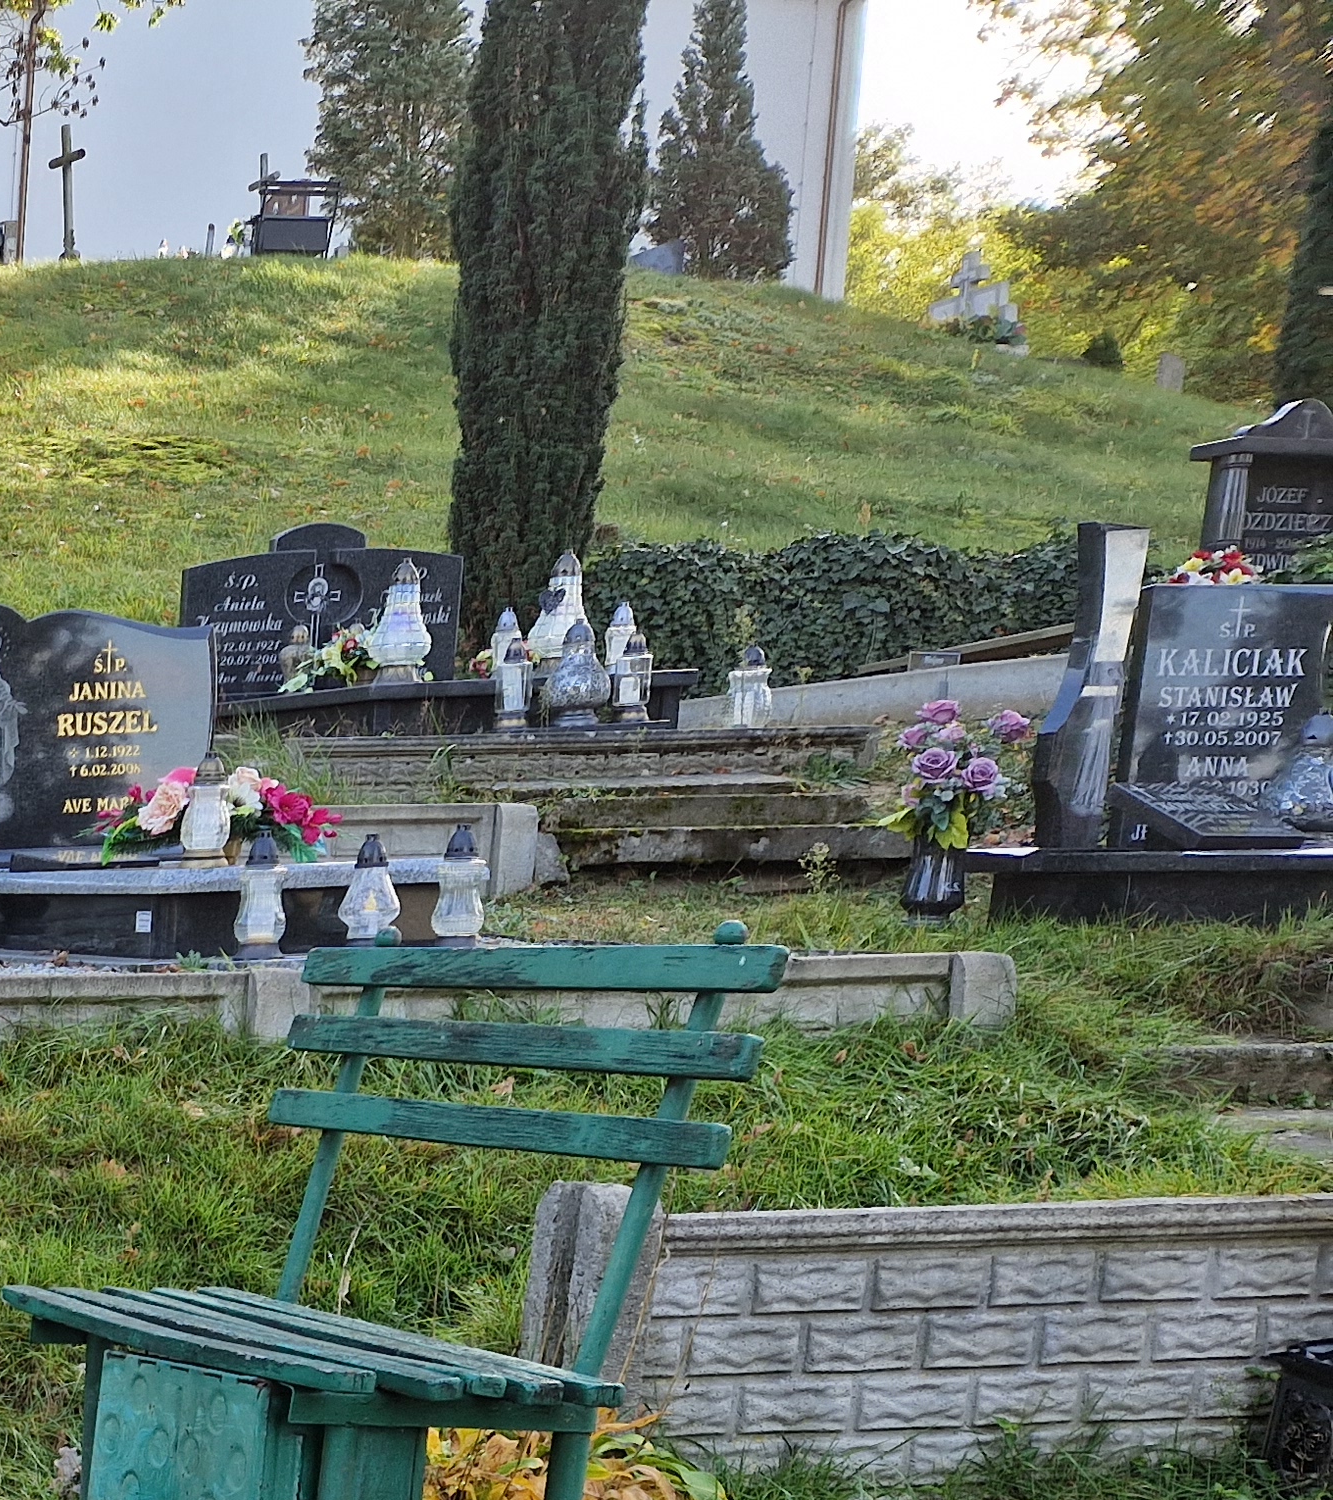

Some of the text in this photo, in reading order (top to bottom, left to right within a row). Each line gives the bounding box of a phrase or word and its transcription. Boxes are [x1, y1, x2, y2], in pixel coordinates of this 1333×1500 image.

[219, 654, 277, 666] 20.07.200
[1155, 648, 1308, 677] KALICIAK
[69, 680, 147, 702] JANINA
[1158, 682, 1301, 708] STANISŁAW
[57, 709, 158, 737] RUSZEL
[1181, 711, 1284, 727] 17.02.1925
[1174, 730, 1282, 747] 30.05.2007
[1184, 756, 1250, 777] ANNA
[63, 797, 134, 814] AVE MAR
